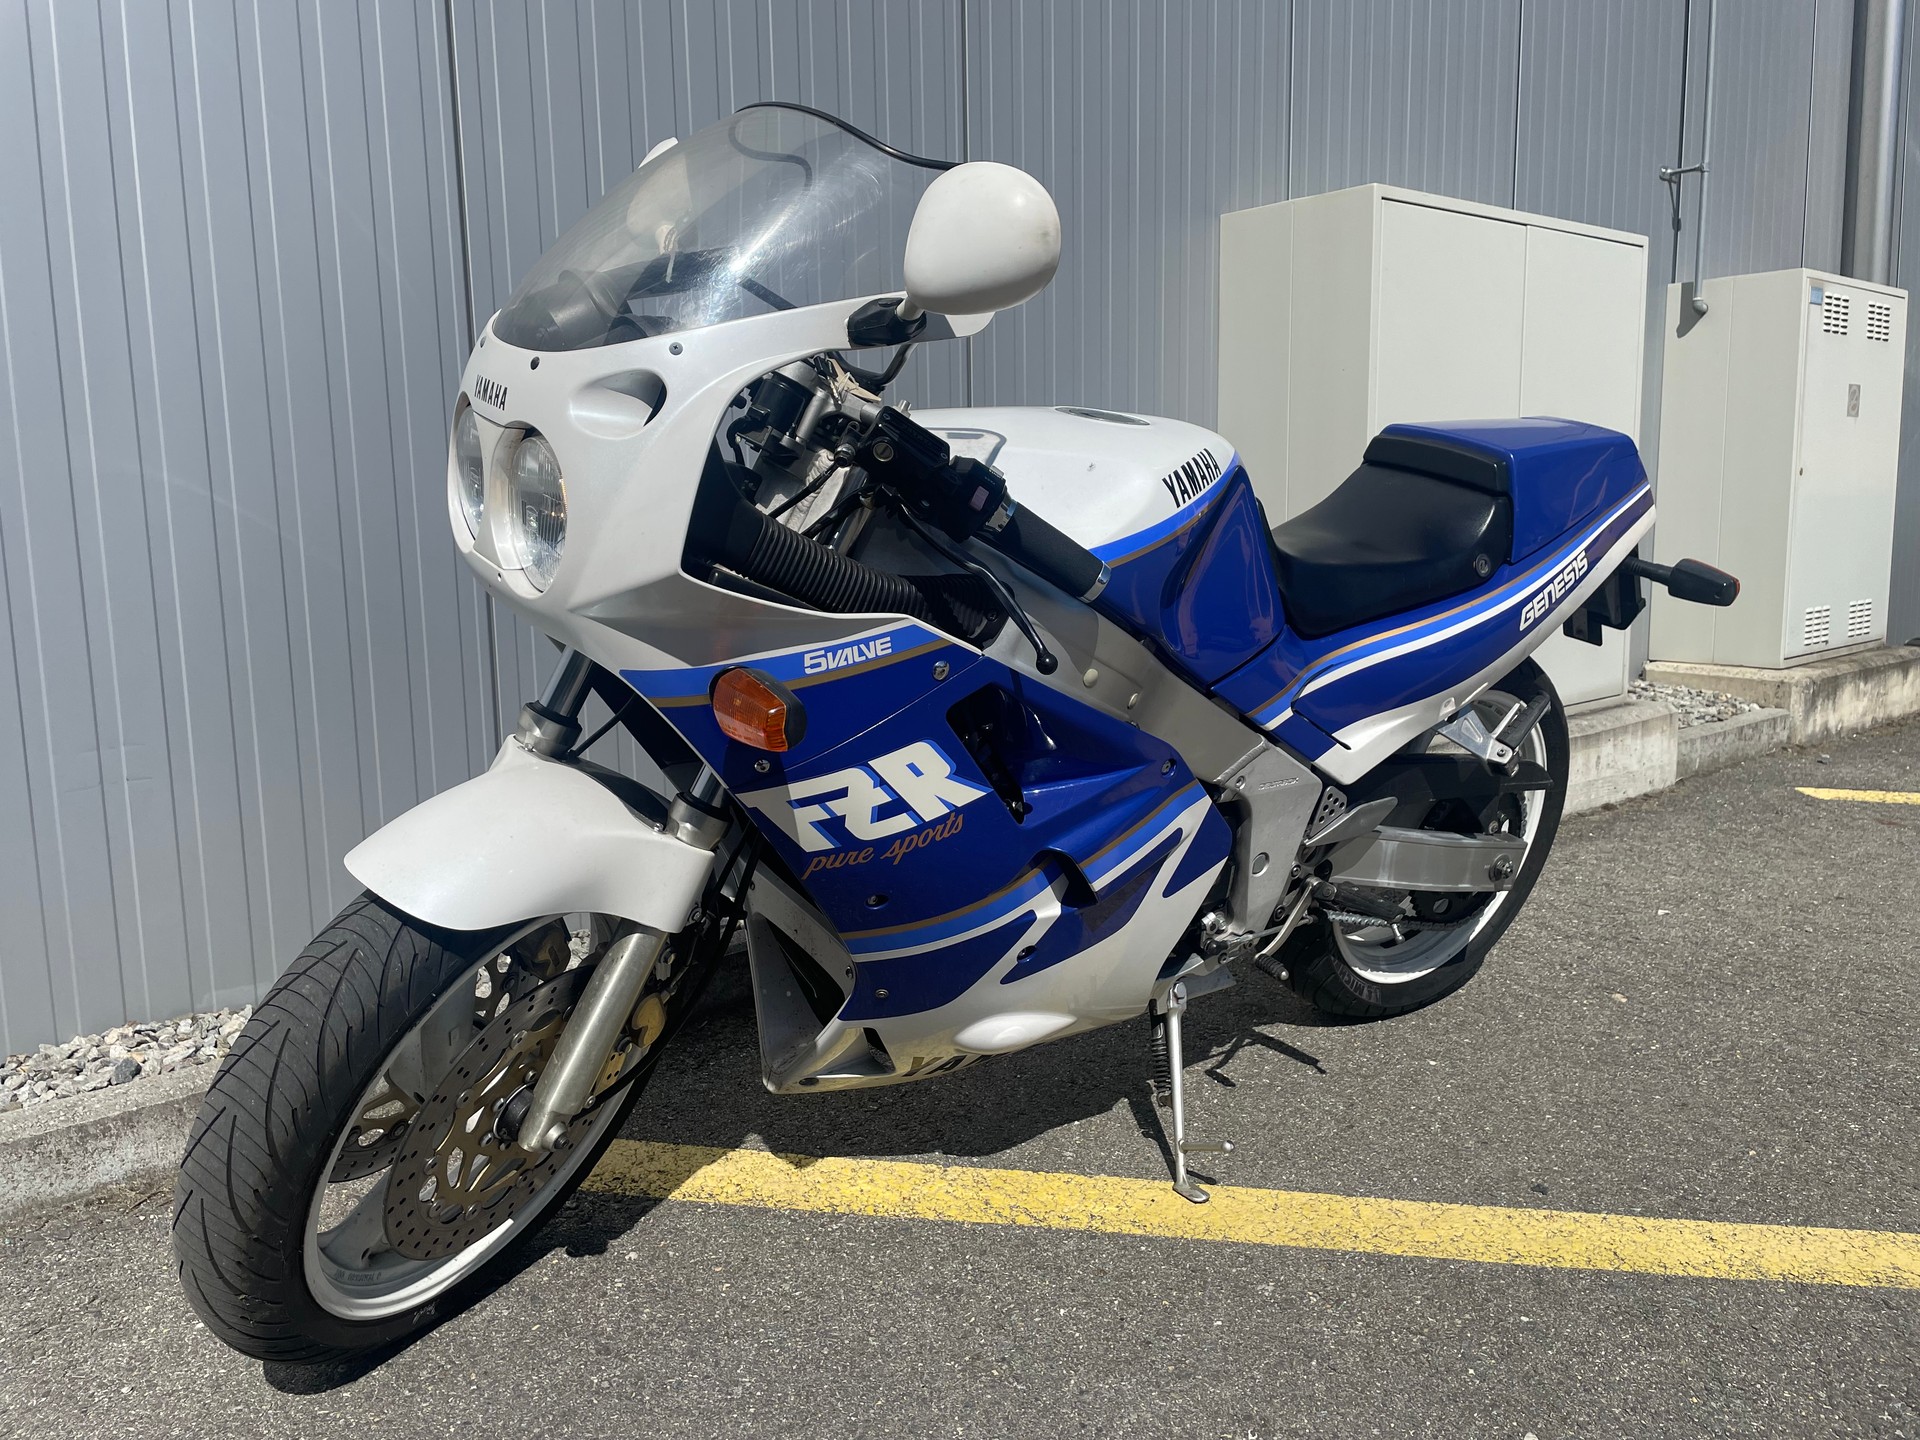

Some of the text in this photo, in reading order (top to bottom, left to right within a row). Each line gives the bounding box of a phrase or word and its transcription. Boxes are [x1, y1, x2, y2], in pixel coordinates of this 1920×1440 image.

[474, 374, 508, 411] YAMAHA
[1162, 447, 1222, 509] YAMAHA
[1520, 550, 1589, 632] GENESIS
[735, 739, 995, 853] FZR
[801, 813, 964, 881] pure sports
